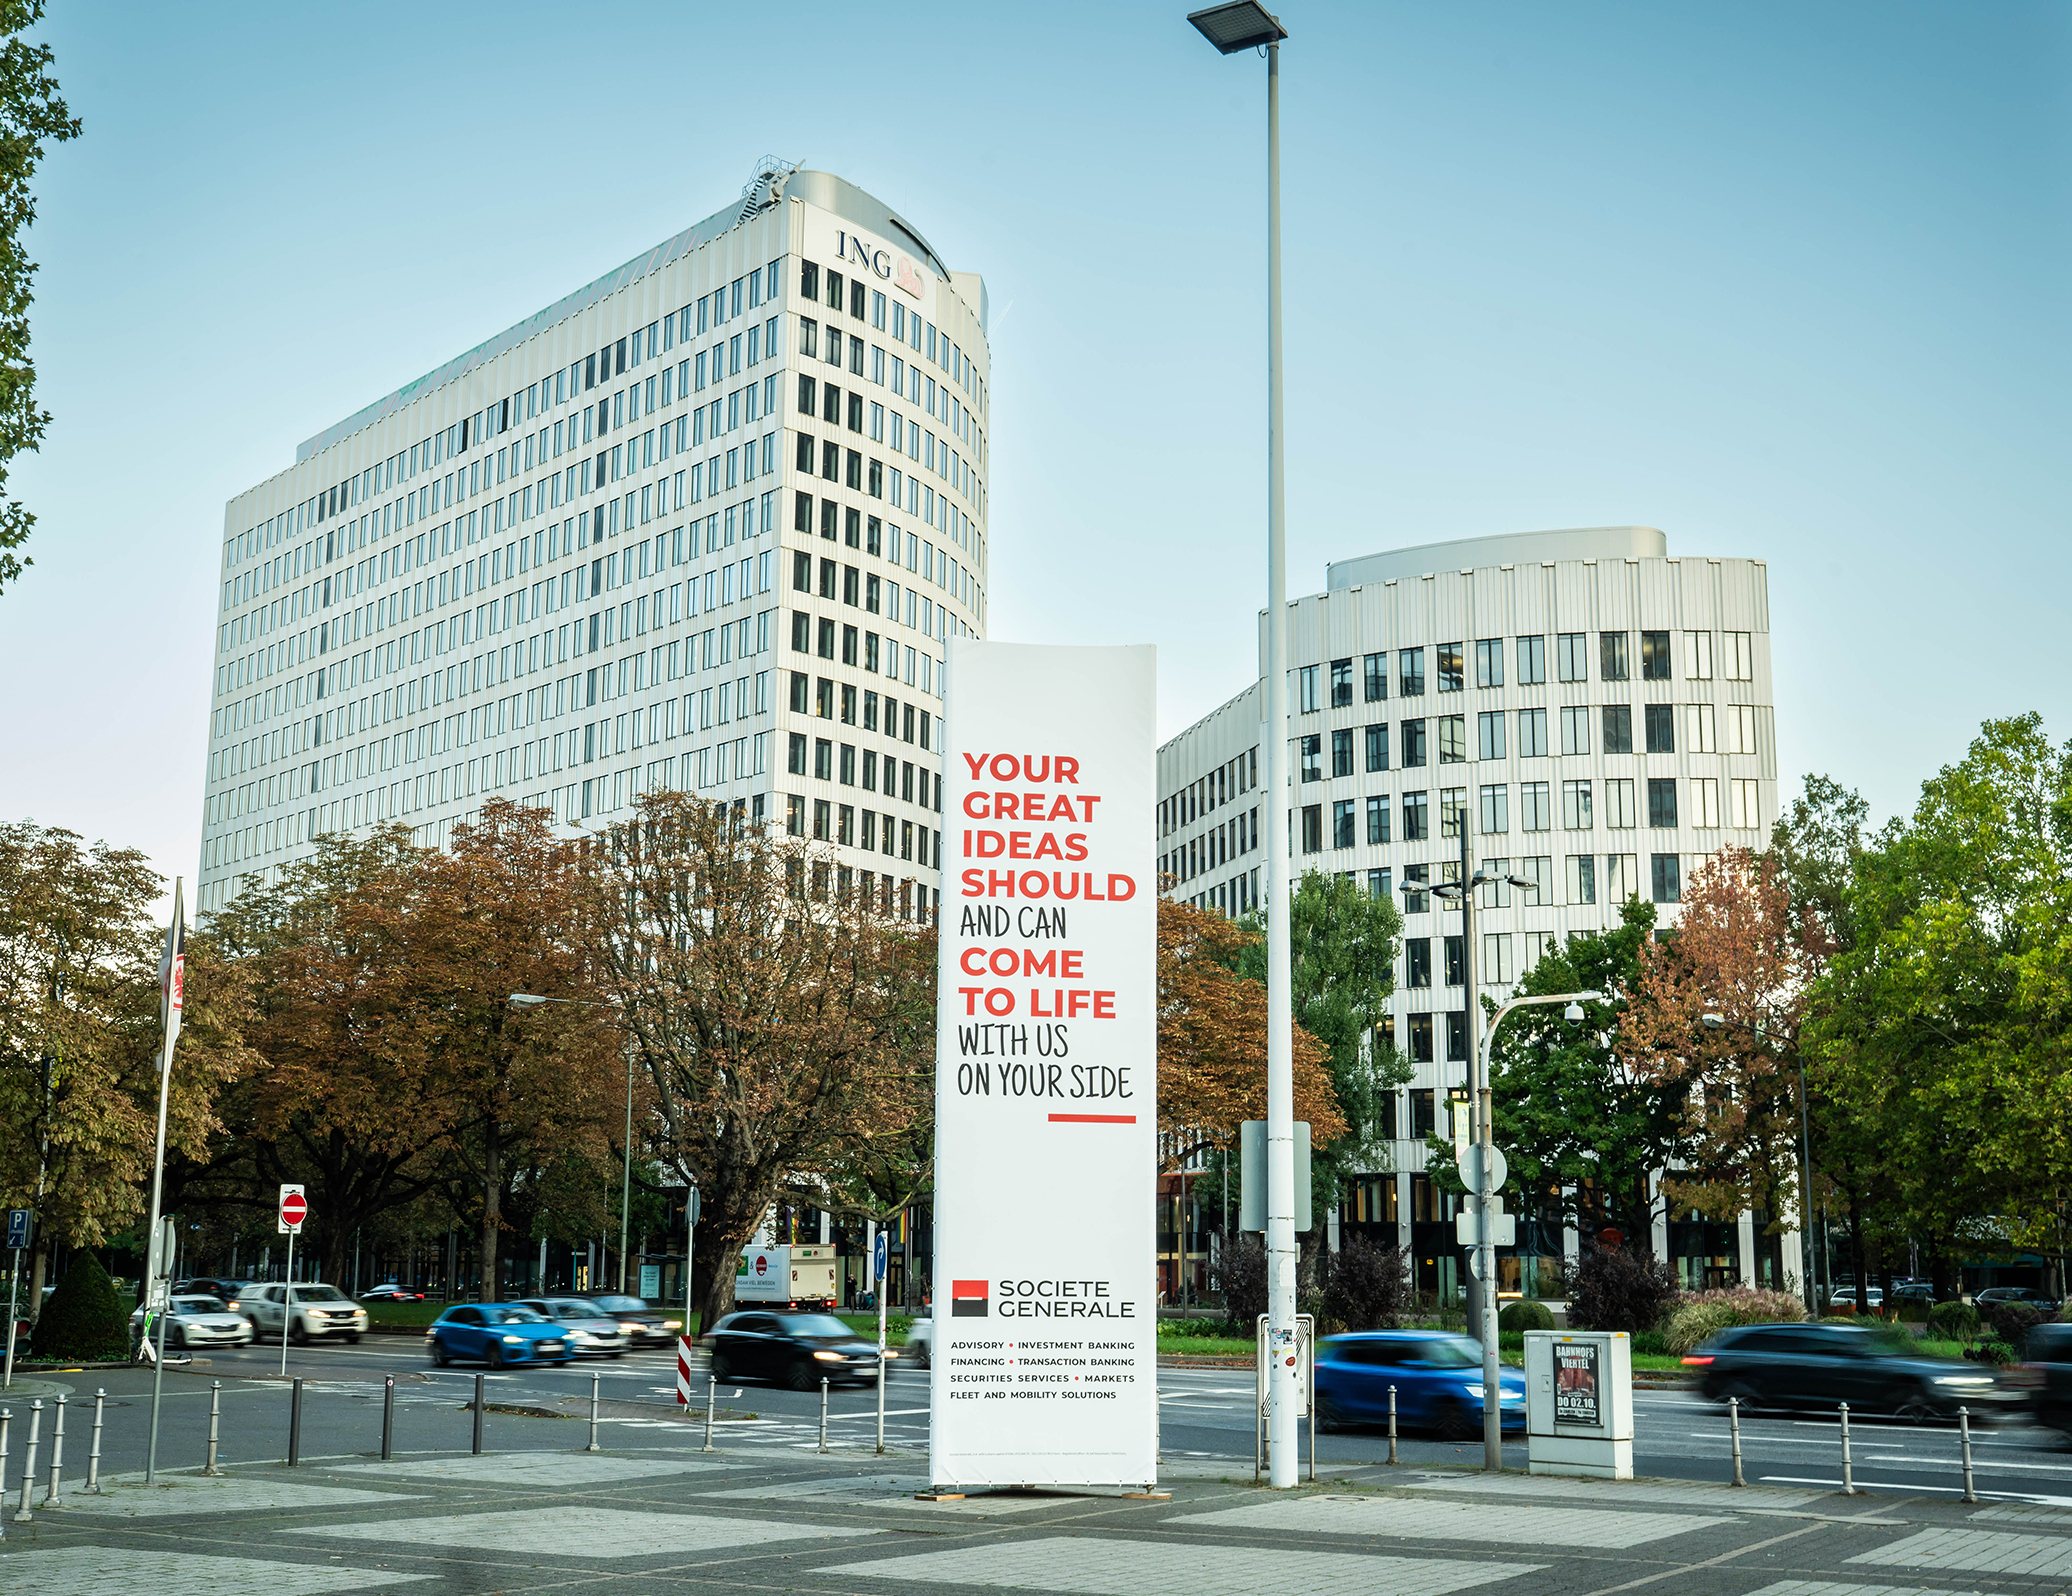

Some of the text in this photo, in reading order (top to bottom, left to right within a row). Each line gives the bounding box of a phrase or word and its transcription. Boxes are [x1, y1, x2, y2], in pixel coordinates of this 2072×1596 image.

[838, 230, 891, 278] ING
[962, 752, 1080, 785] YOUR
[962, 790, 1102, 823] GREAT
[963, 829, 1089, 862] IDEAS
[960, 868, 1137, 902] SHOULD
[959, 904, 1067, 940] AND CAN
[959, 947, 1084, 979] COME
[958, 986, 1117, 1020] TO LIFE
[958, 1022, 1069, 1058] WITH US
[957, 1061, 1134, 1099] ON YOUR SIDE
[14, 1213, 22, 1228] P
[999, 1279, 1110, 1298] SOCIETE
[998, 1300, 1136, 1319] GENERALE
[950, 1341, 1135, 1350] ADVISORY INVESTMENT BANKING
[1556, 1346, 1595, 1358] BAHNHOFS
[950, 1358, 1135, 1367] FINANCING TRANSACTION BANKING
[1561, 1358, 1590, 1369] VIERTEL
[950, 1374, 1135, 1383] SECURITIES SERVICES MARKETS
[950, 1390, 1117, 1400] FLEET AND MOBILITY SOLUTIONS
[1557, 1396, 1596, 1409] DO 02.10.
